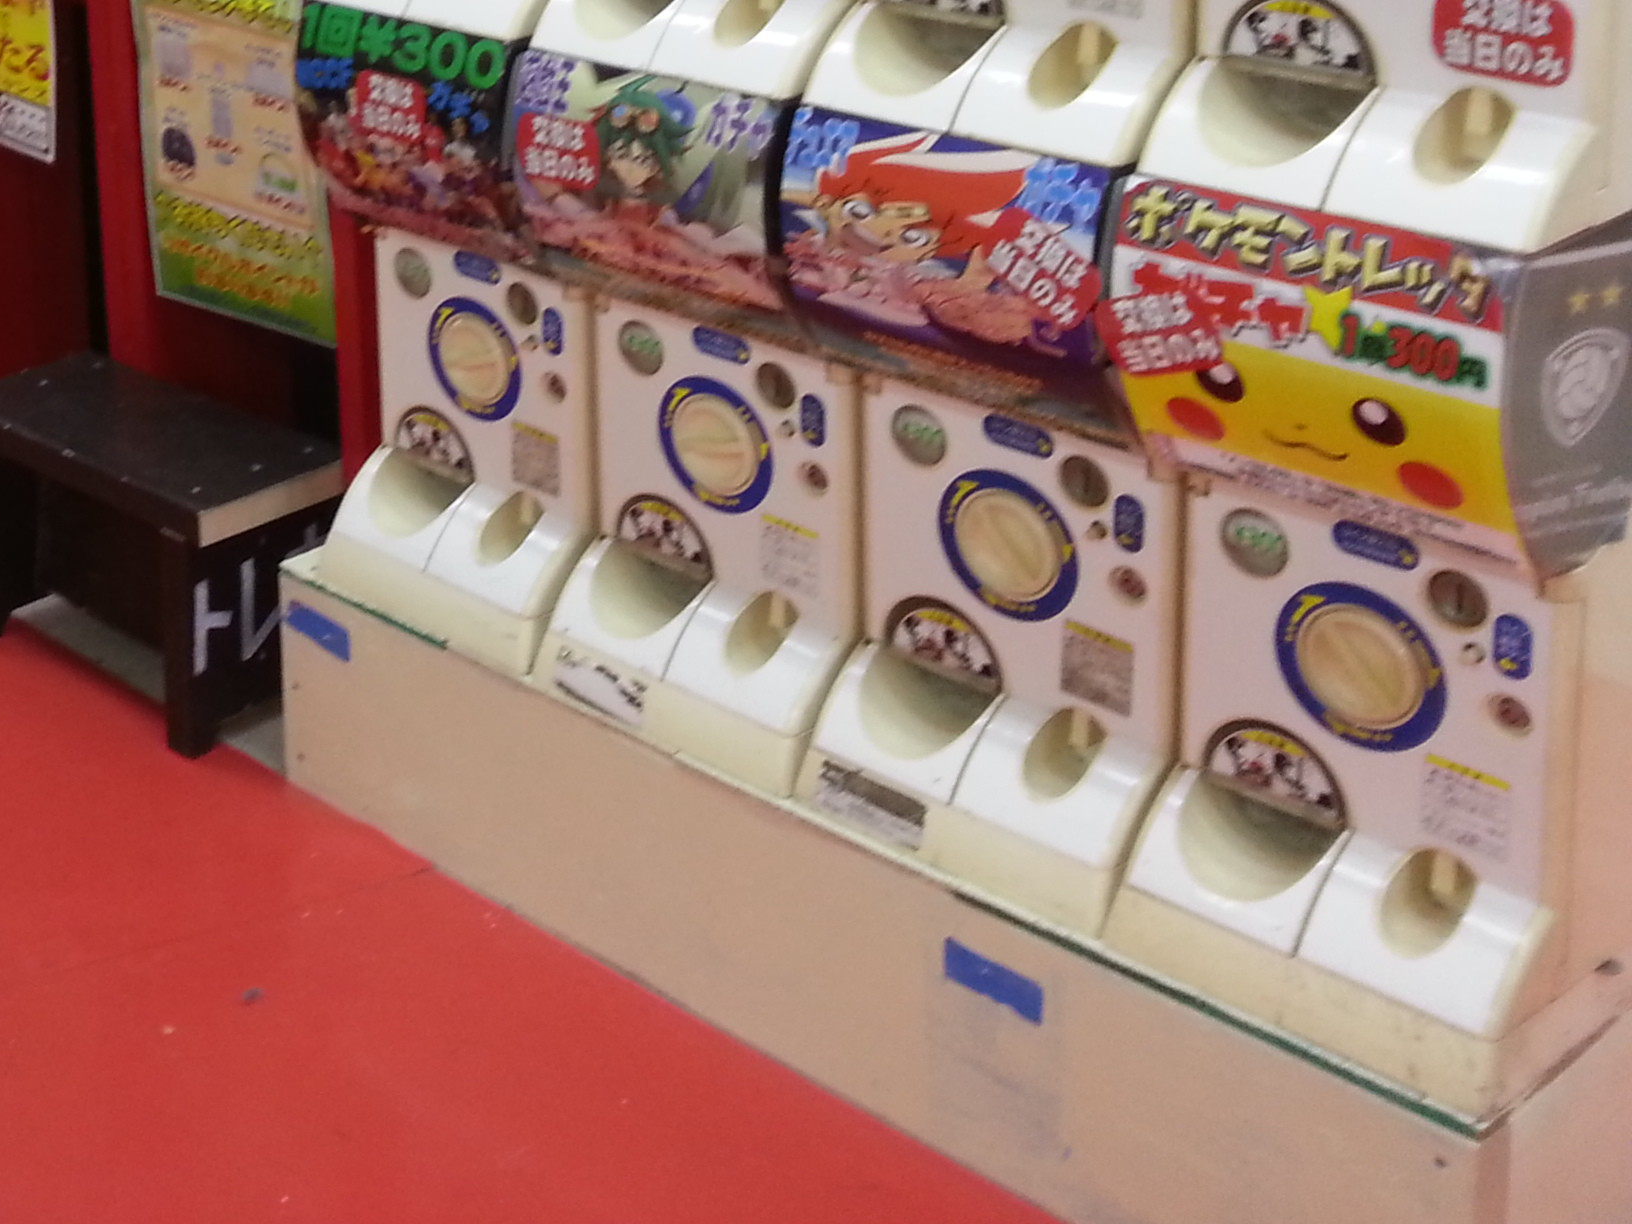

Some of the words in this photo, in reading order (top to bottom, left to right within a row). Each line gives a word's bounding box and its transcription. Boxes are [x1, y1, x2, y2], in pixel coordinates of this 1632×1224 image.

[301, 2, 505, 90] 1回¥300
[1442, 28, 1567, 81] 当日のみ
[986, 238, 1080, 326] 当日のみ
[1014, 219, 1090, 290] 交換は
[1125, 184, 1491, 322] ポケモントレッタ
[1111, 291, 1194, 334] 交換は
[1118, 328, 1221, 373] 当日のみ
